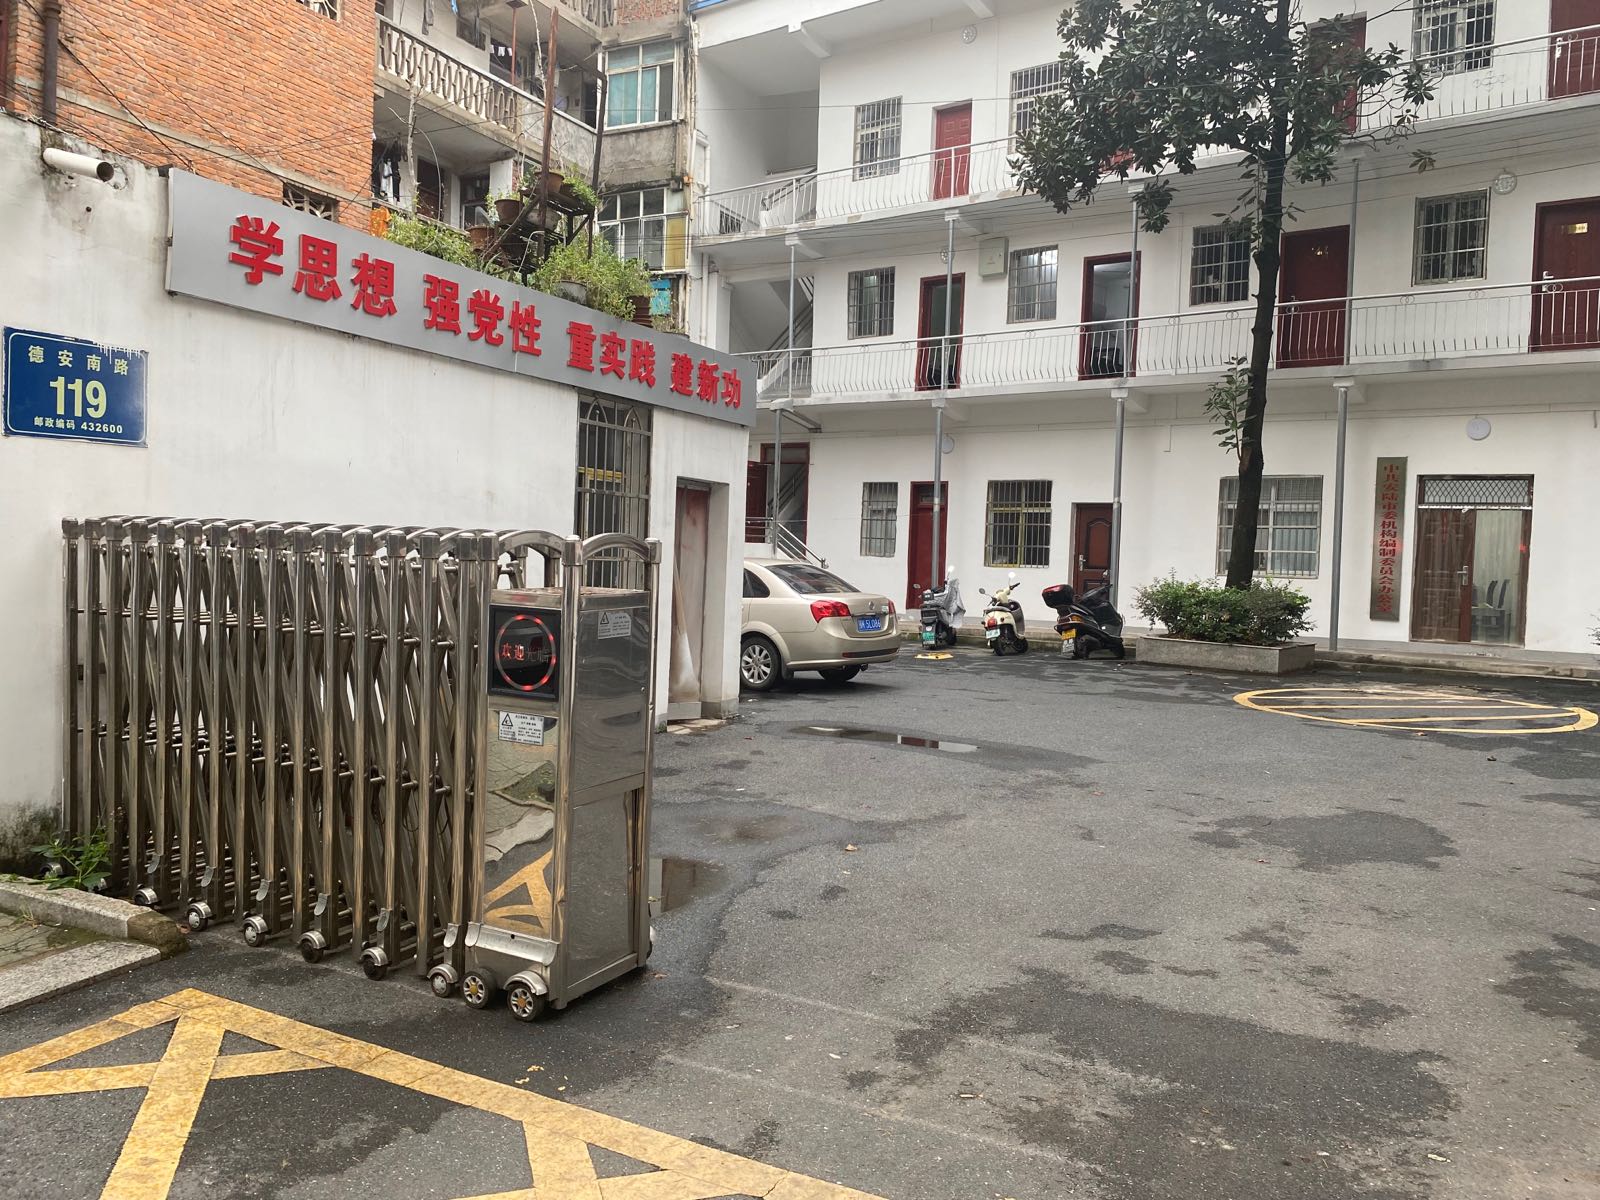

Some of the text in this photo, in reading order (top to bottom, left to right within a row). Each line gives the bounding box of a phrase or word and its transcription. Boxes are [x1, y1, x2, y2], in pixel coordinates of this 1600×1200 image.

[230, 215, 741, 409] 学思想 强党性 重实践 建新功
[28, 344, 129, 375] 德安南路
[49, 376, 107, 418] 119
[33, 416, 123, 434] 邮政编码 432600
[1376, 464, 1399, 612] 中共安陆市委机构编制委员会办公室
